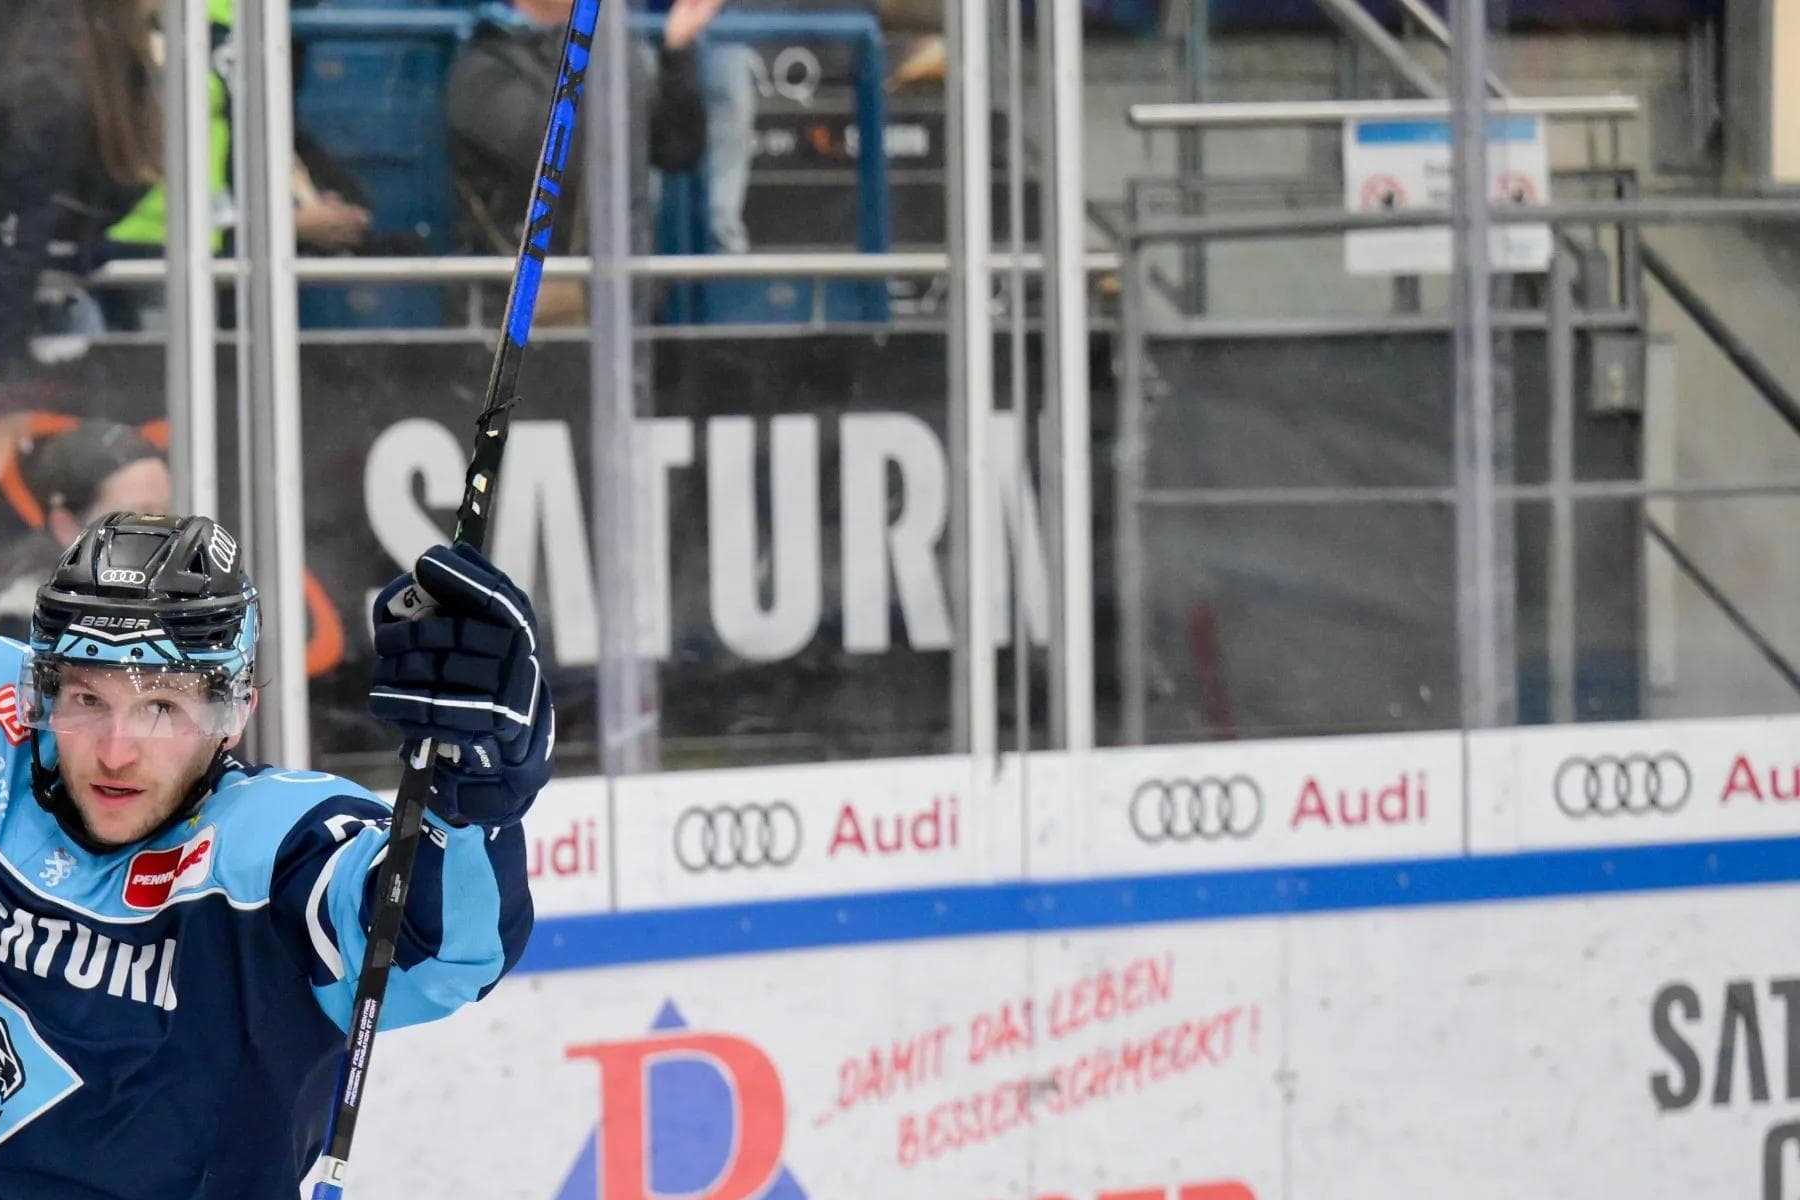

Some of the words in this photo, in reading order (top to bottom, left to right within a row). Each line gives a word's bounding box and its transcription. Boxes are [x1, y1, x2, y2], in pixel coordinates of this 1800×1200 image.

[80, 613, 151, 631] BAUER
[1289, 770, 1428, 830] Audi
[1719, 755, 1800, 803] Au
[528, 819, 598, 879] udi
[826, 796, 960, 859] Audi
[1048, 952, 1175, 1041] LEBEN
[1648, 975, 1800, 1112] SAT
[896, 1073, 1035, 1168] BESSER
